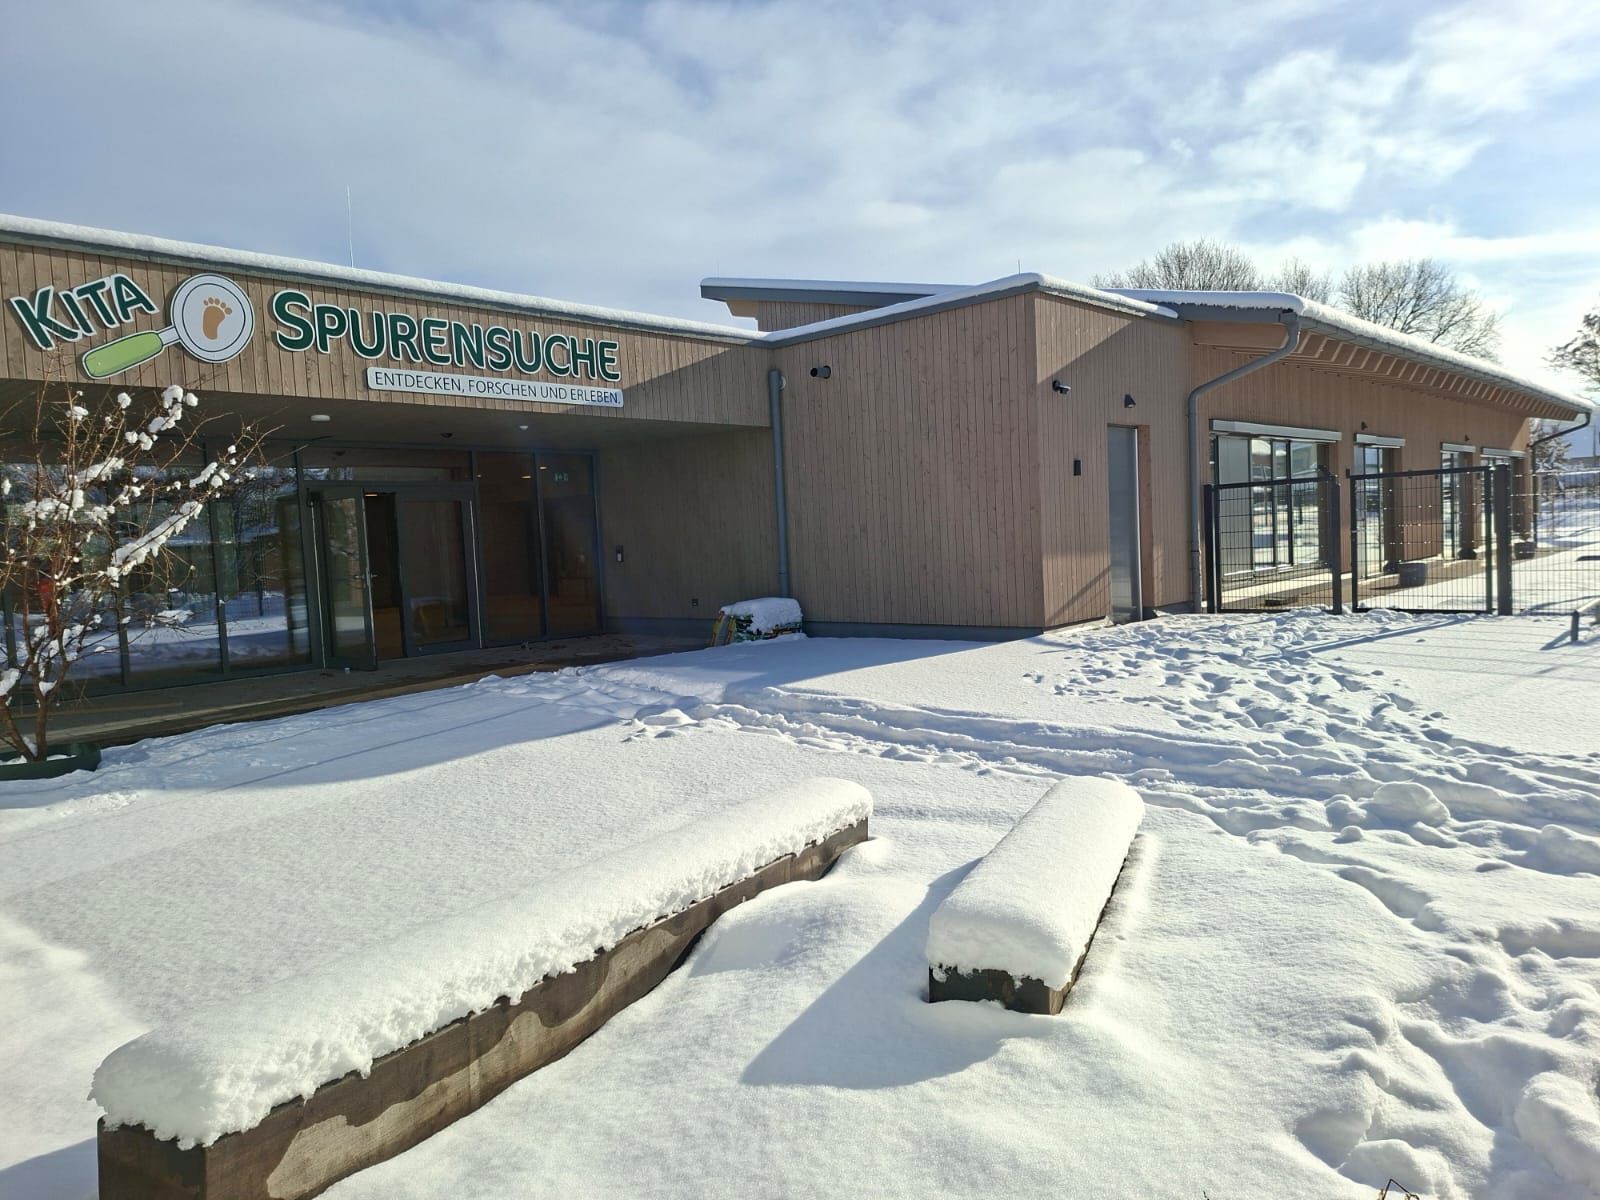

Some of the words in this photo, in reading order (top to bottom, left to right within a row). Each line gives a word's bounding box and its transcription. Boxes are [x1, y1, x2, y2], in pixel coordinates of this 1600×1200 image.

[10, 274, 158, 349] KITA
[272, 290, 621, 381] SPURENSUCHE
[375, 371, 465, 392] ENTDECKEN,
[468, 380, 537, 398] FORSCHEN
[540, 386, 567, 400] UND
[570, 389, 621, 404] ERLEBEN.
